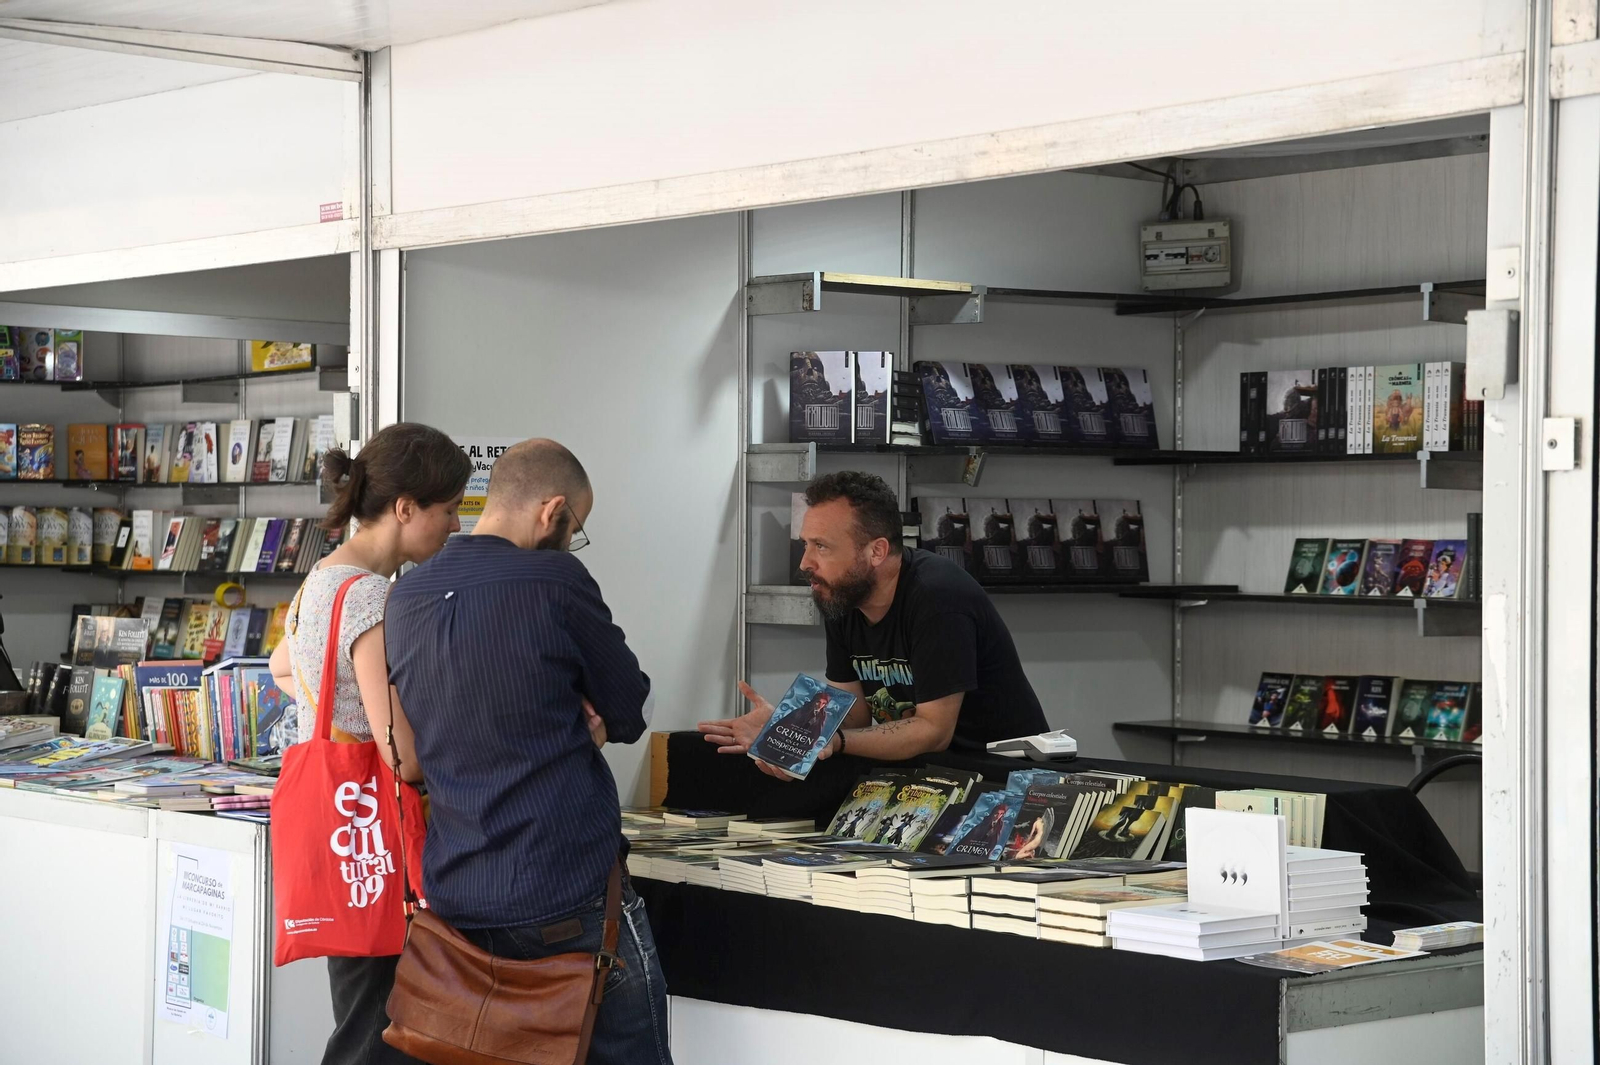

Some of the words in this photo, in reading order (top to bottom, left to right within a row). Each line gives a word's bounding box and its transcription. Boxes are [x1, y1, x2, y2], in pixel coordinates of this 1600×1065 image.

[469, 445, 483, 458] AL
[487, 446, 511, 458] RET
[74, 676, 85, 685] KEN
[166, 672, 188, 686] 100
[69, 683, 89, 694] FOLLETT
[775, 725, 815, 746] CRIMEN
[1066, 777, 1085, 787] Cuerpos
[1084, 779, 1107, 788] celestiales
[334, 775, 379, 828] es
[1028, 790, 1046, 799] Cuerpos
[1045, 792, 1068, 800] celestiales
[330, 819, 389, 861] cul
[955, 844, 991, 857] CRIMEN
[339, 852, 397, 884] tural
